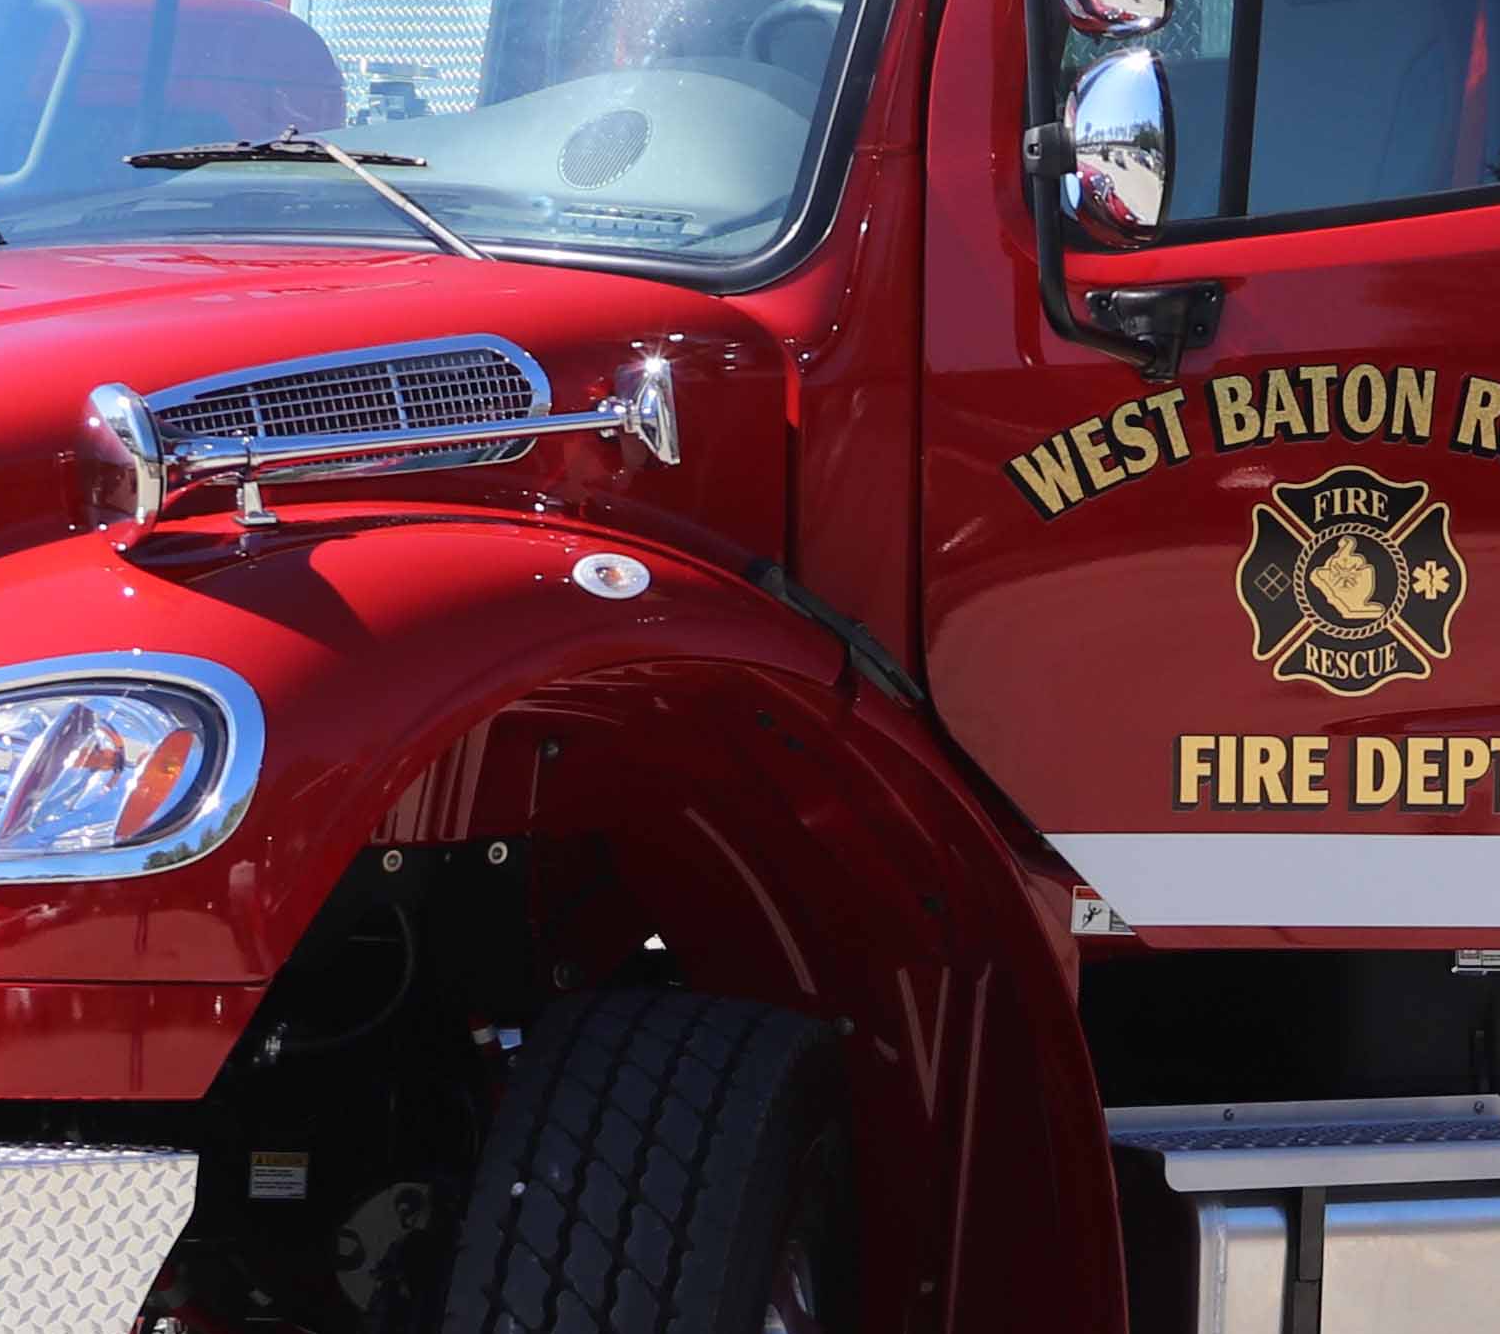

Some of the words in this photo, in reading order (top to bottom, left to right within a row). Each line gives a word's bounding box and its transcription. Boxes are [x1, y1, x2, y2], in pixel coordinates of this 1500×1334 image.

[1006, 387, 1191, 518] WEST
[1208, 364, 1437, 451] BATON
[1313, 487, 1389, 523] FIRE
[1305, 641, 1398, 679] RESCUE
[1177, 734, 1330, 808] FIRE
